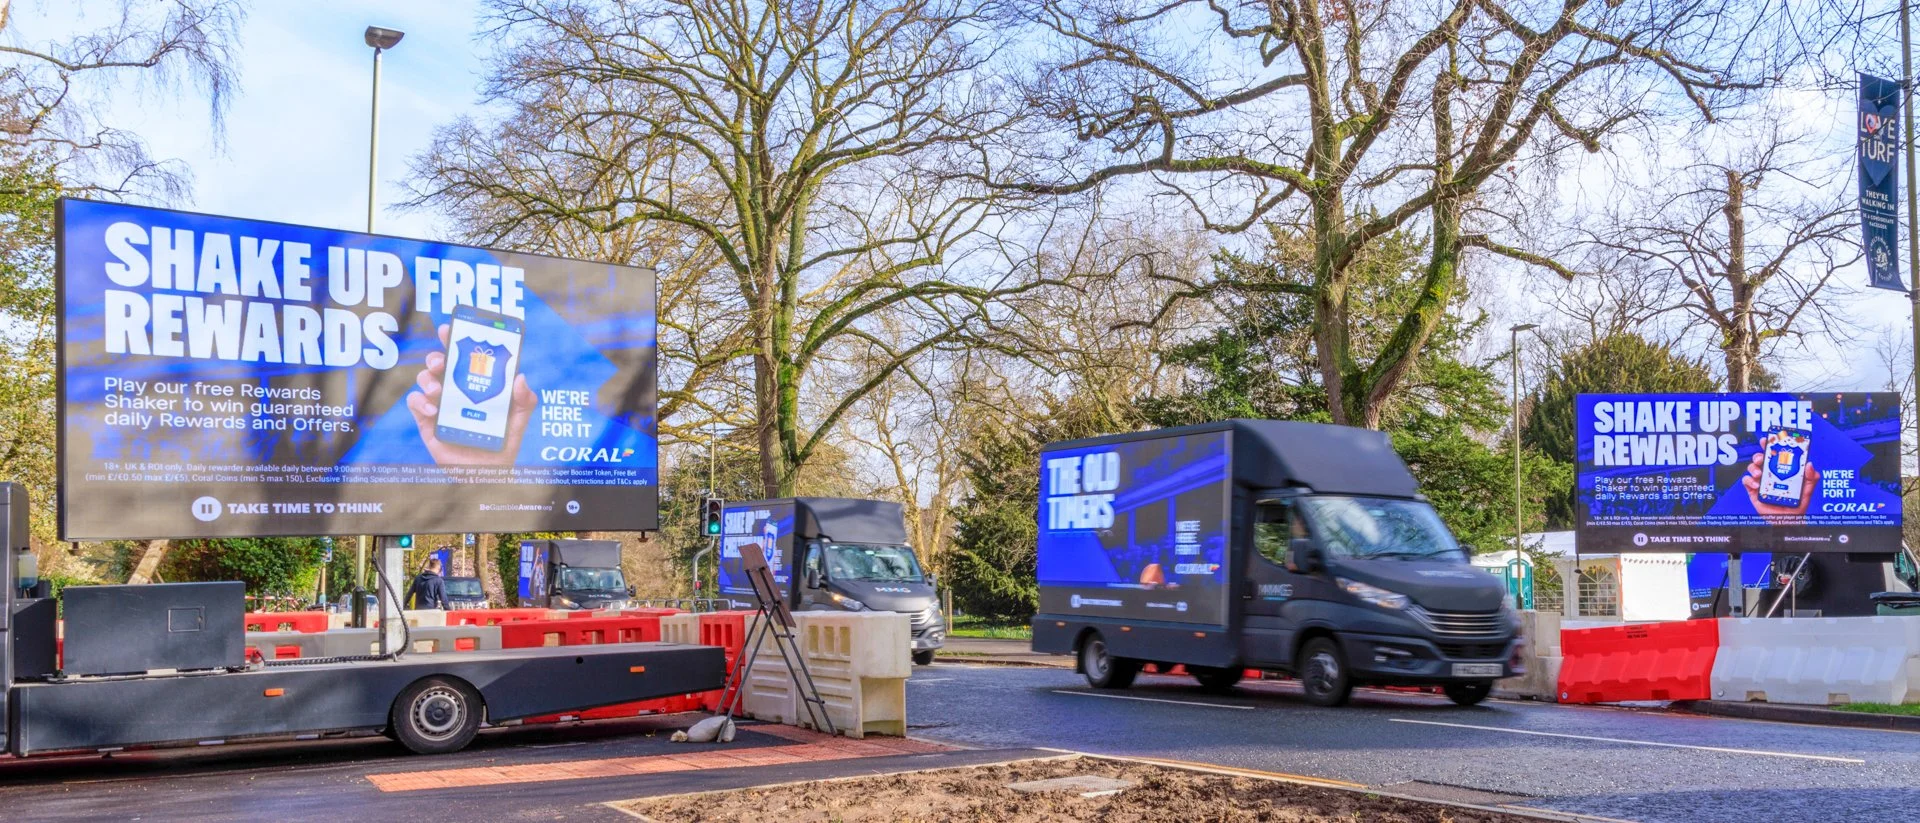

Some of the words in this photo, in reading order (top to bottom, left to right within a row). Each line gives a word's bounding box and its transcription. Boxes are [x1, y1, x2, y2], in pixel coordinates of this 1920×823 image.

[1860, 136, 1895, 163] TURF
[105, 221, 311, 301] SHAKE
[328, 246, 403, 307] UP
[415, 256, 525, 320] FREE
[105, 289, 399, 370] REWARDS
[467, 374, 492, 386] FREE
[104, 377, 147, 395] Play
[154, 382, 187, 394] our
[195, 382, 234, 396] free
[241, 384, 321, 400] Rewards
[468, 383, 489, 393] BET
[541, 389, 590, 406] WE'RE
[104, 394, 177, 411] Shaker
[184, 398, 203, 412] to
[211, 399, 243, 413] win
[251, 403, 354, 418] guaranteed
[542, 406, 582, 421] HERE
[104, 411, 152, 429] daily
[160, 413, 246, 429] Rewards
[252, 417, 286, 430] and
[293, 418, 354, 433] Offers.
[1593, 401, 1692, 433] SHAKE
[1699, 400, 1740, 433] UP
[1746, 400, 1812, 432] FREE
[542, 422, 575, 437] FOR
[578, 423, 592, 438] IT
[541, 446, 622, 463] CORAL
[1594, 434, 1738, 466] REWARDS
[125, 463, 137, 471] UK
[140, 463, 146, 471] &
[148, 463, 163, 471] ROI
[186, 463, 207, 473] Daily
[208, 464, 243, 472] rewarder
[246, 464, 280, 473] available
[281, 464, 299, 474] daily
[301, 465, 333, 473] between
[334, 465, 361, 473] 9:00am
[401, 466, 416, 474] Max
[466, 467, 477, 476] per
[478, 467, 497, 476] player
[552, 469, 570, 477] Super
[594, 469, 613, 477] Token,
[1047, 456, 1081, 495] THE
[1083, 452, 1120, 492] OLD
[1822, 470, 1854, 479] WE'RE
[85, 472, 106, 482] (min
[192, 473, 214, 482] Coral
[215, 474, 238, 482] Coins
[240, 474, 258, 483] (min
[285, 474, 305, 483] 150),
[306, 475, 341, 483] Exclusive
[342, 475, 369, 484] Trading
[370, 475, 399, 484] Specials
[415, 476, 446, 484] Exclusive
[448, 476, 467, 484] Offers
[633, 478, 648, 486] apply
[1595, 476, 1614, 486] Play
[1635, 476, 1654, 484] free
[1657, 476, 1697, 484] Rewards
[1823, 480, 1849, 488] HERE
[1595, 484, 1627, 492] Shaker
[1630, 484, 1640, 492] to
[1643, 484, 1659, 492] win
[1662, 484, 1714, 493] guaranteed
[1823, 489, 1845, 498] FOR
[1846, 489, 1856, 498] IT
[1595, 492, 1616, 502] daily
[1620, 492, 1660, 500] Rewards
[1663, 492, 1680, 500] and
[1682, 492, 1714, 500] Offers.
[227, 503, 269, 514] TAKE
[273, 503, 310, 514] TIME
[313, 503, 335, 513] TO
[337, 502, 383, 513] THINK
[1047, 493, 1115, 530] TIMERS
[1822, 503, 1876, 512] CORAL
